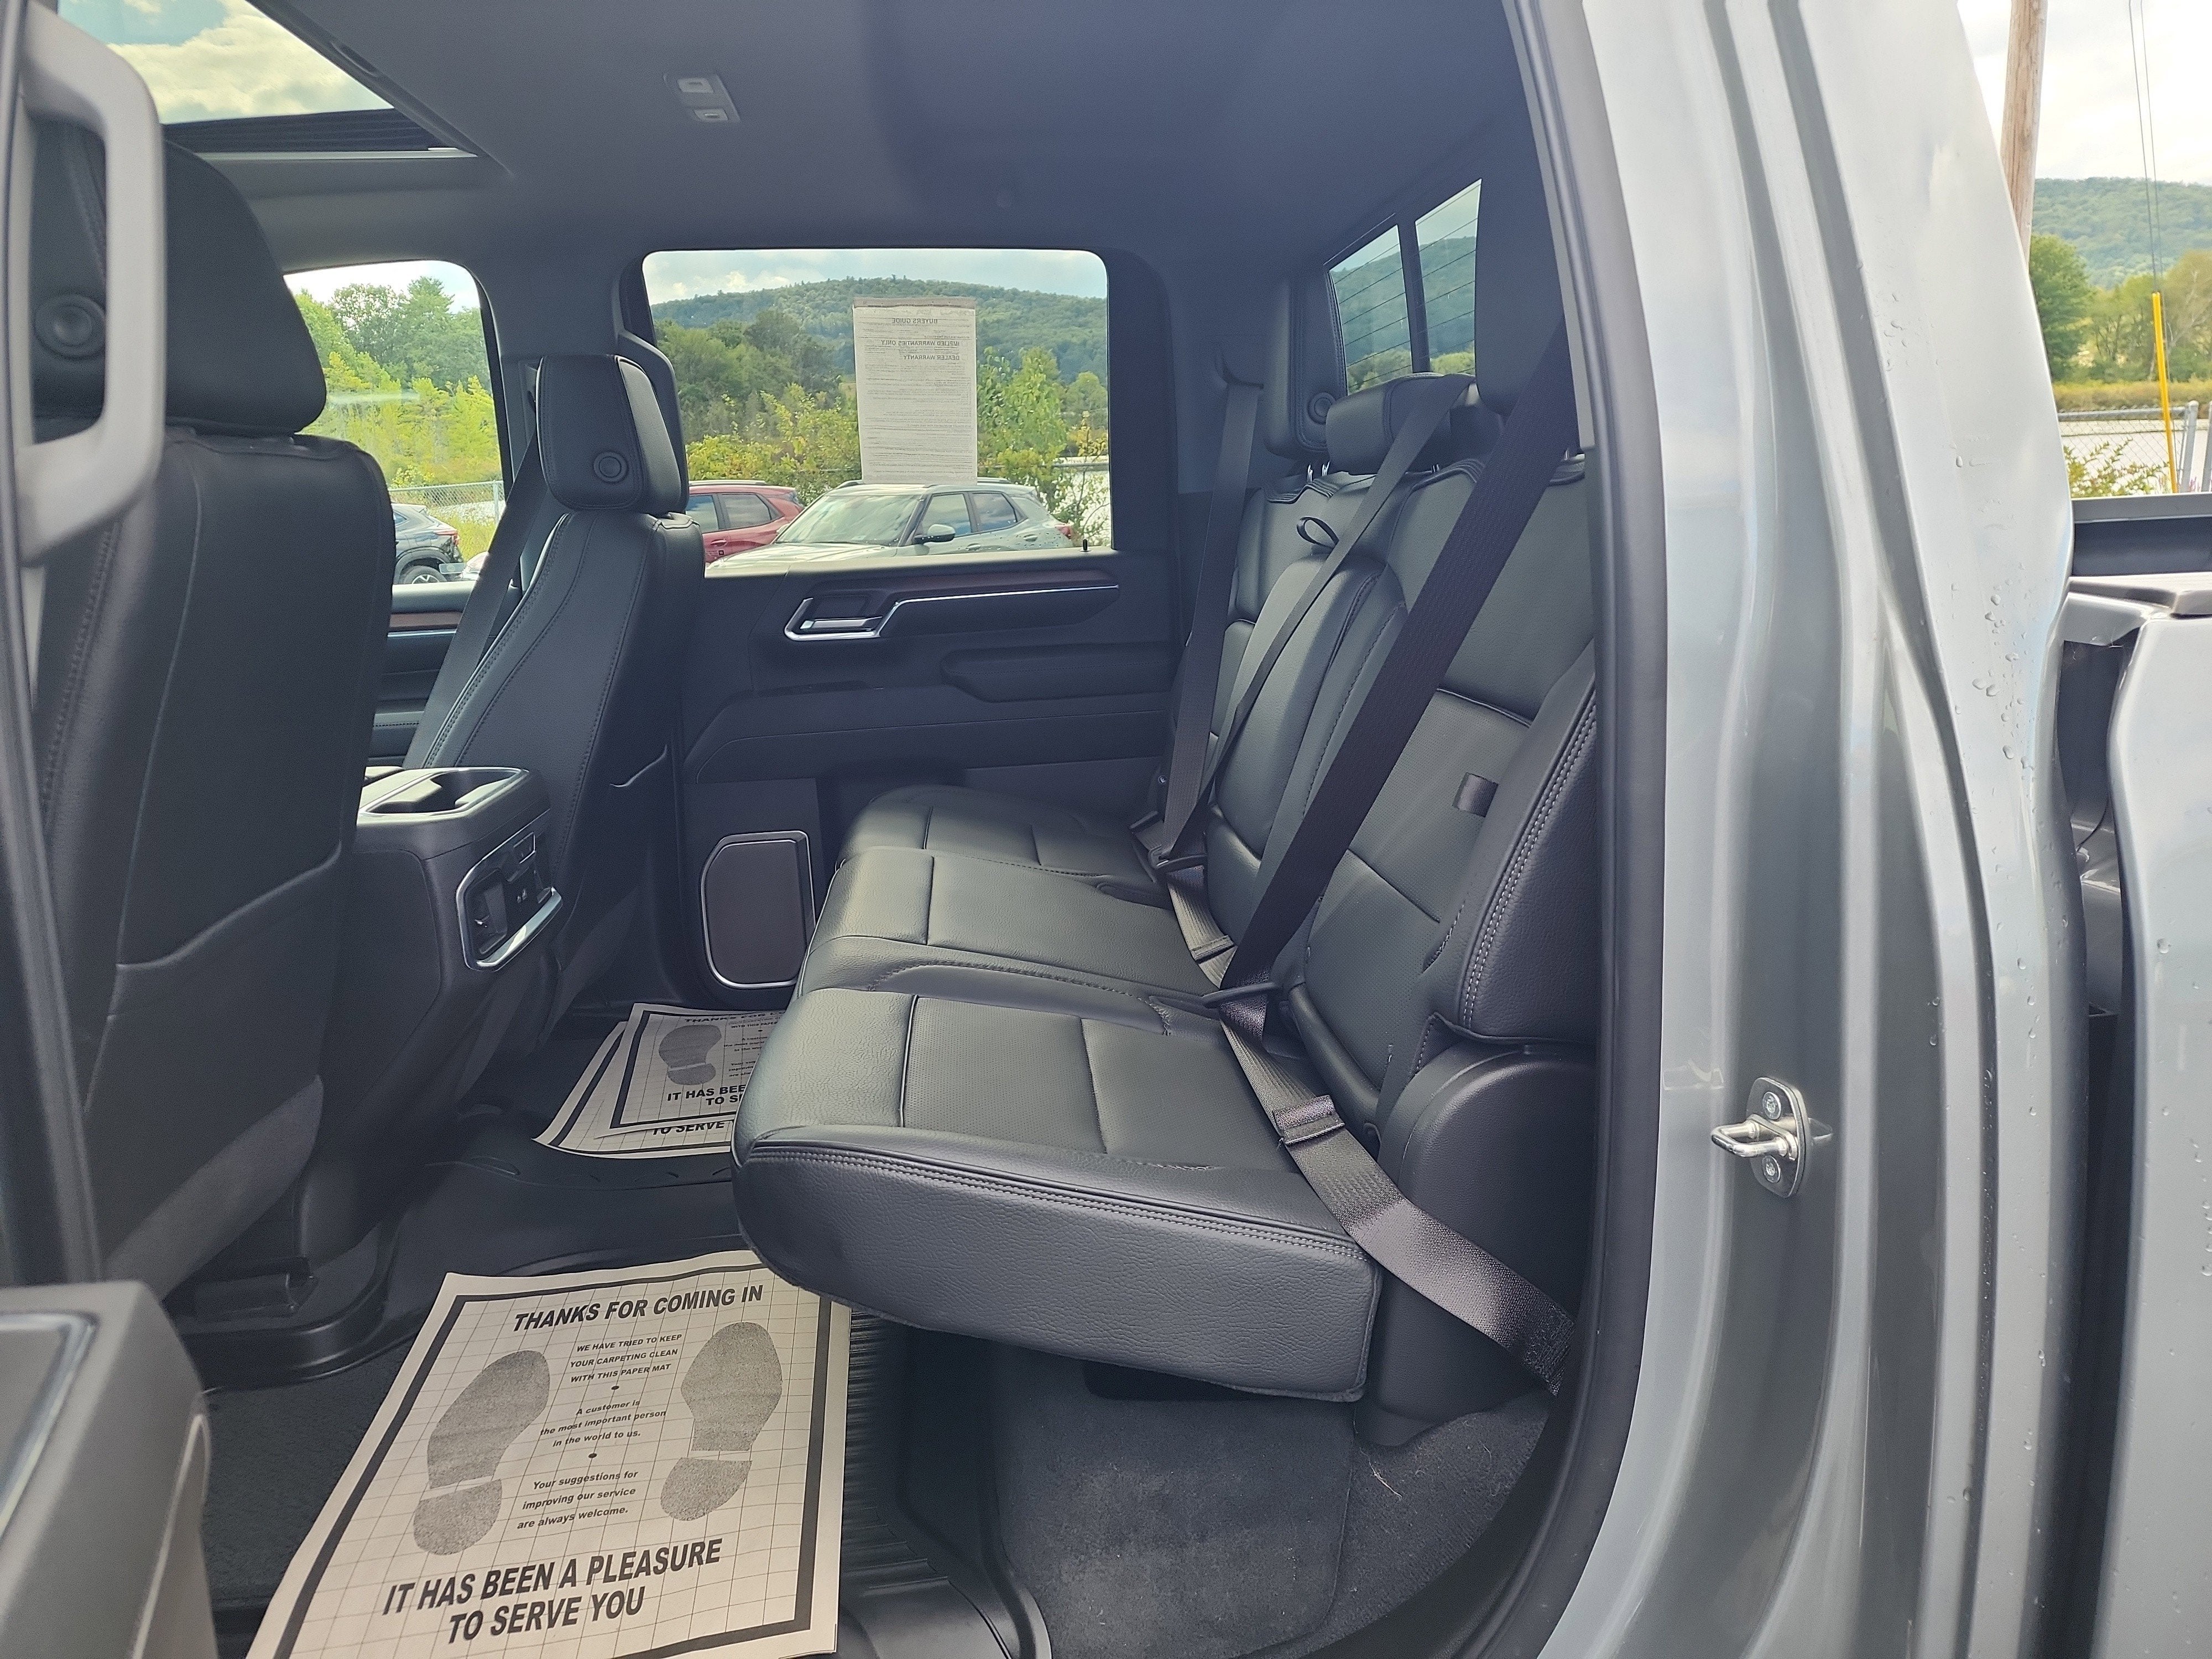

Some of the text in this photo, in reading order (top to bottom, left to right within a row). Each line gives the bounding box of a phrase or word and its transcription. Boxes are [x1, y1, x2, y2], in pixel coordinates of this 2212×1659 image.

[667, 1084, 747, 1101] IT HAS BEE
[706, 1097, 724, 1105] TO
[676, 1121, 725, 1133] SERVE
[513, 1285, 763, 1332] THANKS FOR COMING IN
[659, 1334, 682, 1342] KEEP
[571, 1349, 678, 1368] YOUR CARPETING CLEAN
[571, 1364, 671, 1383] WITH THIS PAPER MAT
[586, 1402, 630, 1413] customer
[557, 1422, 582, 1432] most
[585, 1414, 632, 1427] important
[634, 1411, 666, 1421] person
[565, 1436, 581, 1444] the
[584, 1431, 612, 1441] world
[533, 1480, 556, 1490] Your
[559, 1472, 620, 1485] suggestions
[522, 1488, 636, 1510] improving our service
[517, 1506, 628, 1529] are always welcome.
[382, 1538, 723, 1615] IT HAS BEEN A PLEASURE
[448, 1585, 646, 1644] TO SERVE YOU
